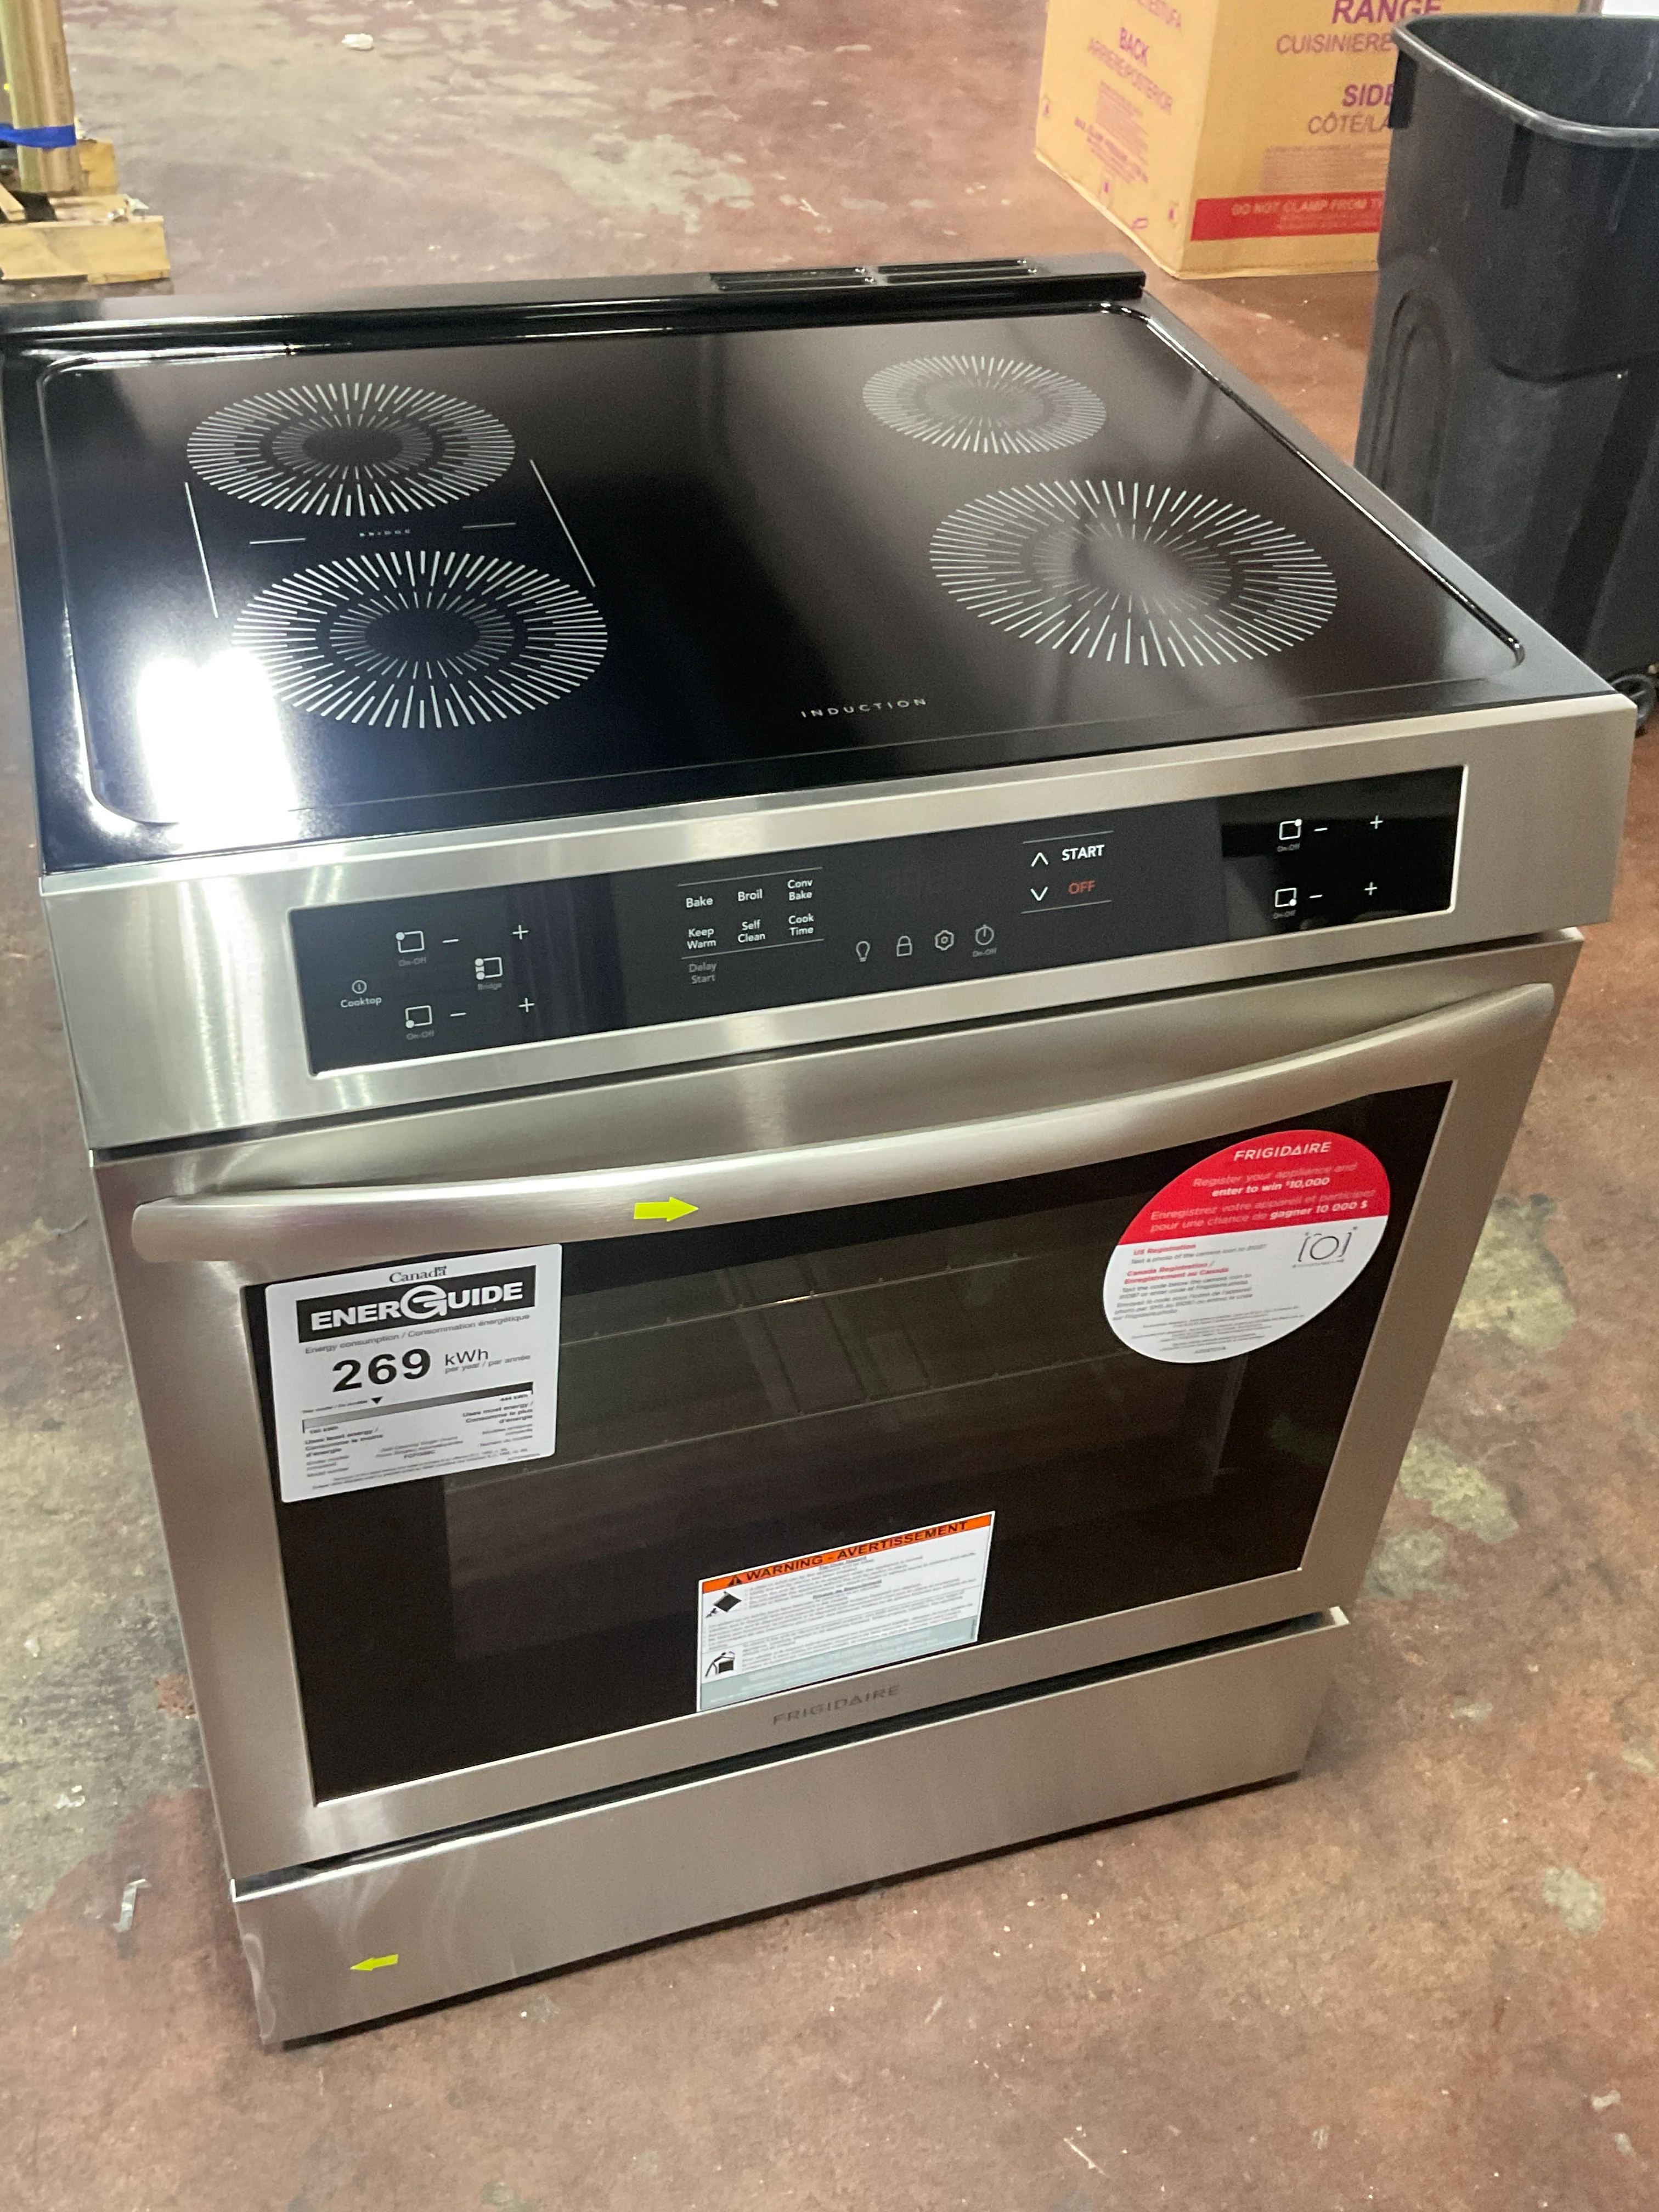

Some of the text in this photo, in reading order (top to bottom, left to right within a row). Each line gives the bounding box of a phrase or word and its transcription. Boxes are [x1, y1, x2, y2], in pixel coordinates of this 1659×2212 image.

[1119, 27, 1149, 67] BACK
[801, 698, 926, 718] INDUCTION
[1061, 844, 1105, 861] START
[787, 879, 813, 889] Conv
[1068, 880, 1095, 895] OFF
[686, 896, 714, 908] Bake
[737, 889, 763, 902] Broil
[788, 890, 813, 901] Bake
[741, 919, 761, 930] Self
[788, 913, 814, 924] Cook
[688, 928, 714, 938] Keep
[789, 926, 814, 936] Time
[687, 939, 716, 950] Warm
[737, 933, 766, 943] Clean
[689, 961, 718, 973] Delay
[691, 974, 716, 984] Start
[340, 996, 382, 1008] Cooktop
[1233, 1142, 1331, 1161] FRIGIDAIRE
[1193, 1176, 1243, 1188] Register
[1211, 1187, 1244, 1197] enter
[1246, 1184, 1259, 1194] to
[1262, 1182, 1282, 1192] win
[1150, 1222, 1180, 1233] pour
[1182, 1220, 1205, 1229] une
[1269, 1208, 1313, 1220] gagner
[1315, 1204, 1329, 1214] 10
[1331, 1201, 1358, 1212] 000
[1359, 1200, 1368, 1209] $
[389, 1265, 446, 1283] Canada
[311, 1282, 523, 1331] ENERGUIDE
[305, 1343, 337, 1355] Energy
[340, 1333, 399, 1350] consumption
[332, 1348, 489, 1393] 269 kWh
[746, 1555, 823, 1581] WARNING
[837, 1521, 968, 1560] AVERTISSEMENT
[772, 1685, 902, 1725] FRIGIDAIRE
